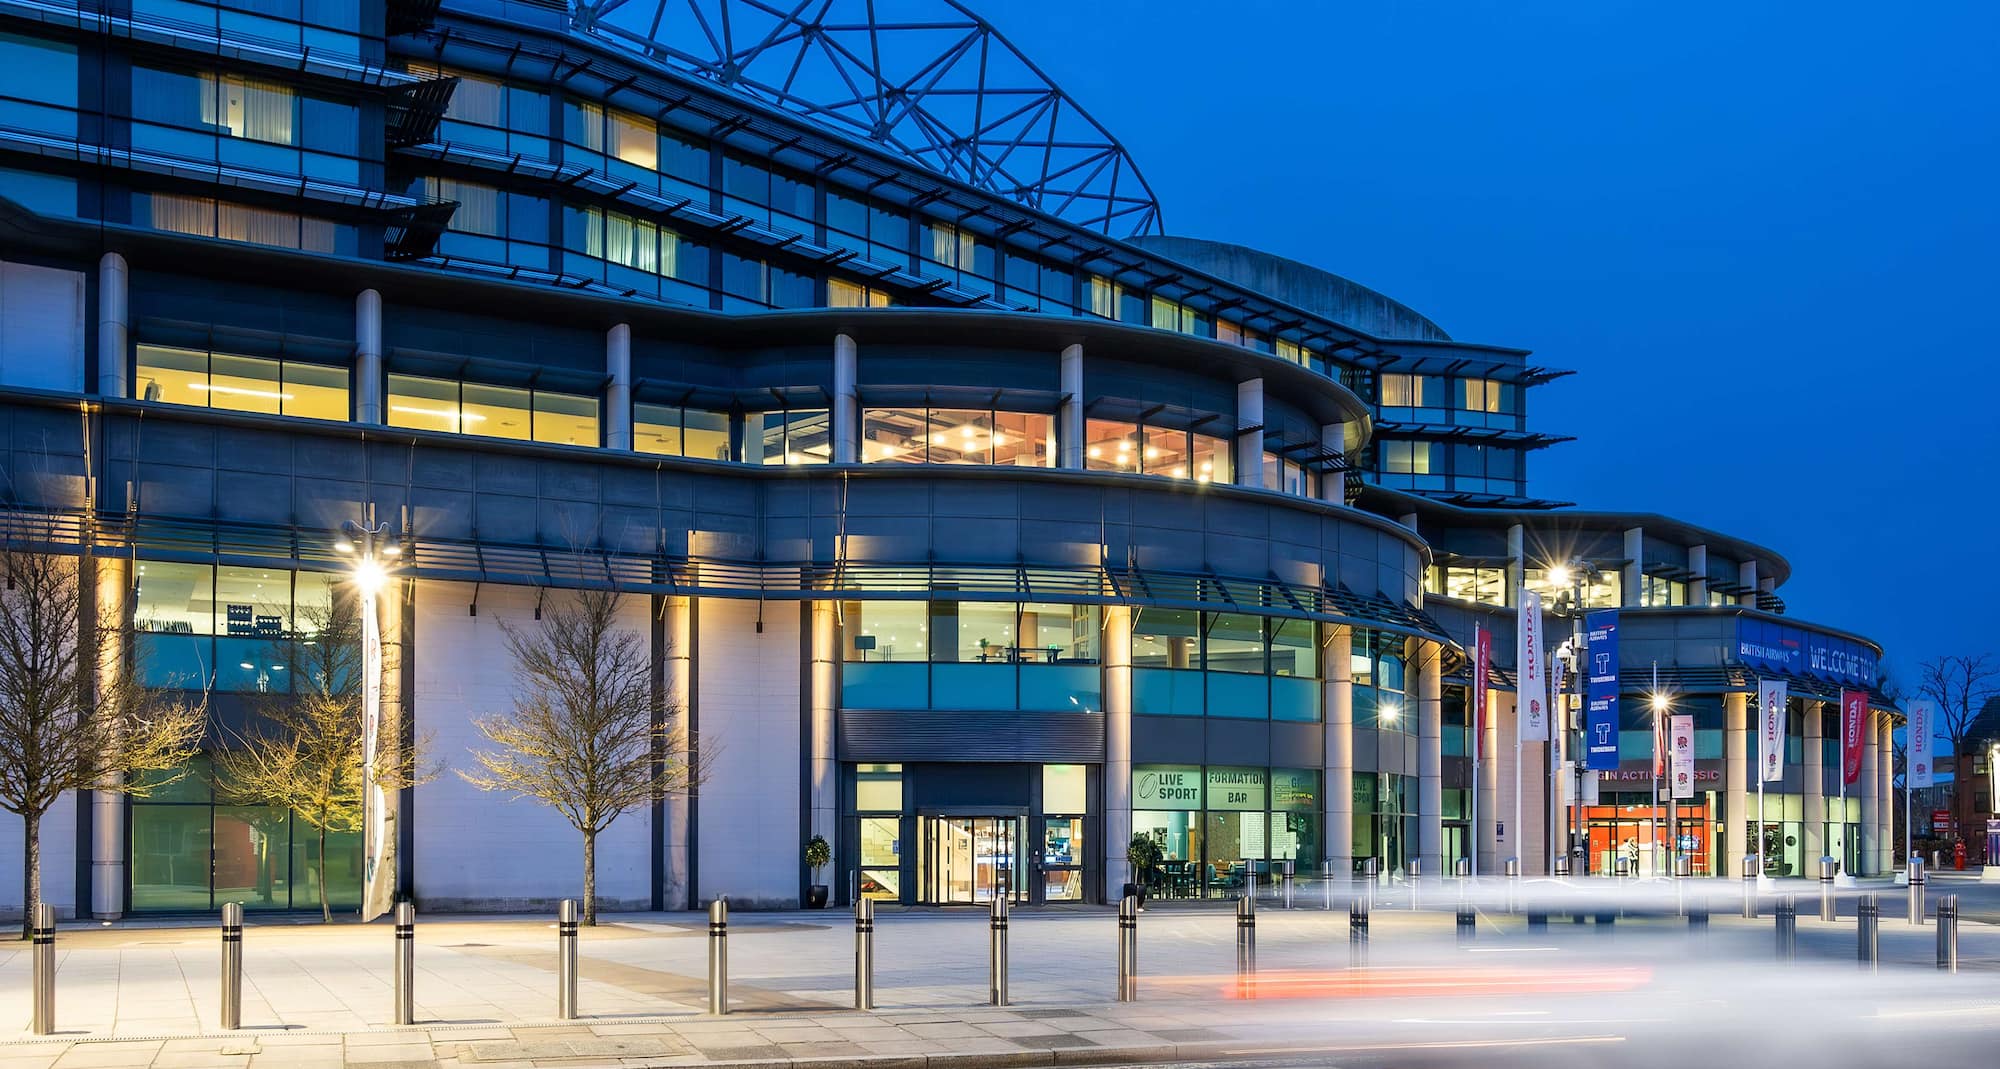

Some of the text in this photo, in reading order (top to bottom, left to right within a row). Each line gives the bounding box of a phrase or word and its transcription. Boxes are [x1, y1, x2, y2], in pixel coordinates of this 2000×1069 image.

[1526, 607, 1535, 680] HONDA
[1741, 642, 1789, 662] BRITISH AIRWAYS
[1810, 645, 1859, 677] WELCOME
[1768, 690, 1776, 741] HONDA
[1848, 699, 1858, 748] HONDA
[1915, 708, 1923, 753] HONDA
[1159, 774, 1183, 785] LIVE
[1209, 772, 1265, 784] FORMATION
[1599, 770, 1618, 780] GIN
[1693, 770, 1720, 780] SSIC
[1159, 788, 1198, 799] SPORT
[1228, 792, 1247, 803] BAR
